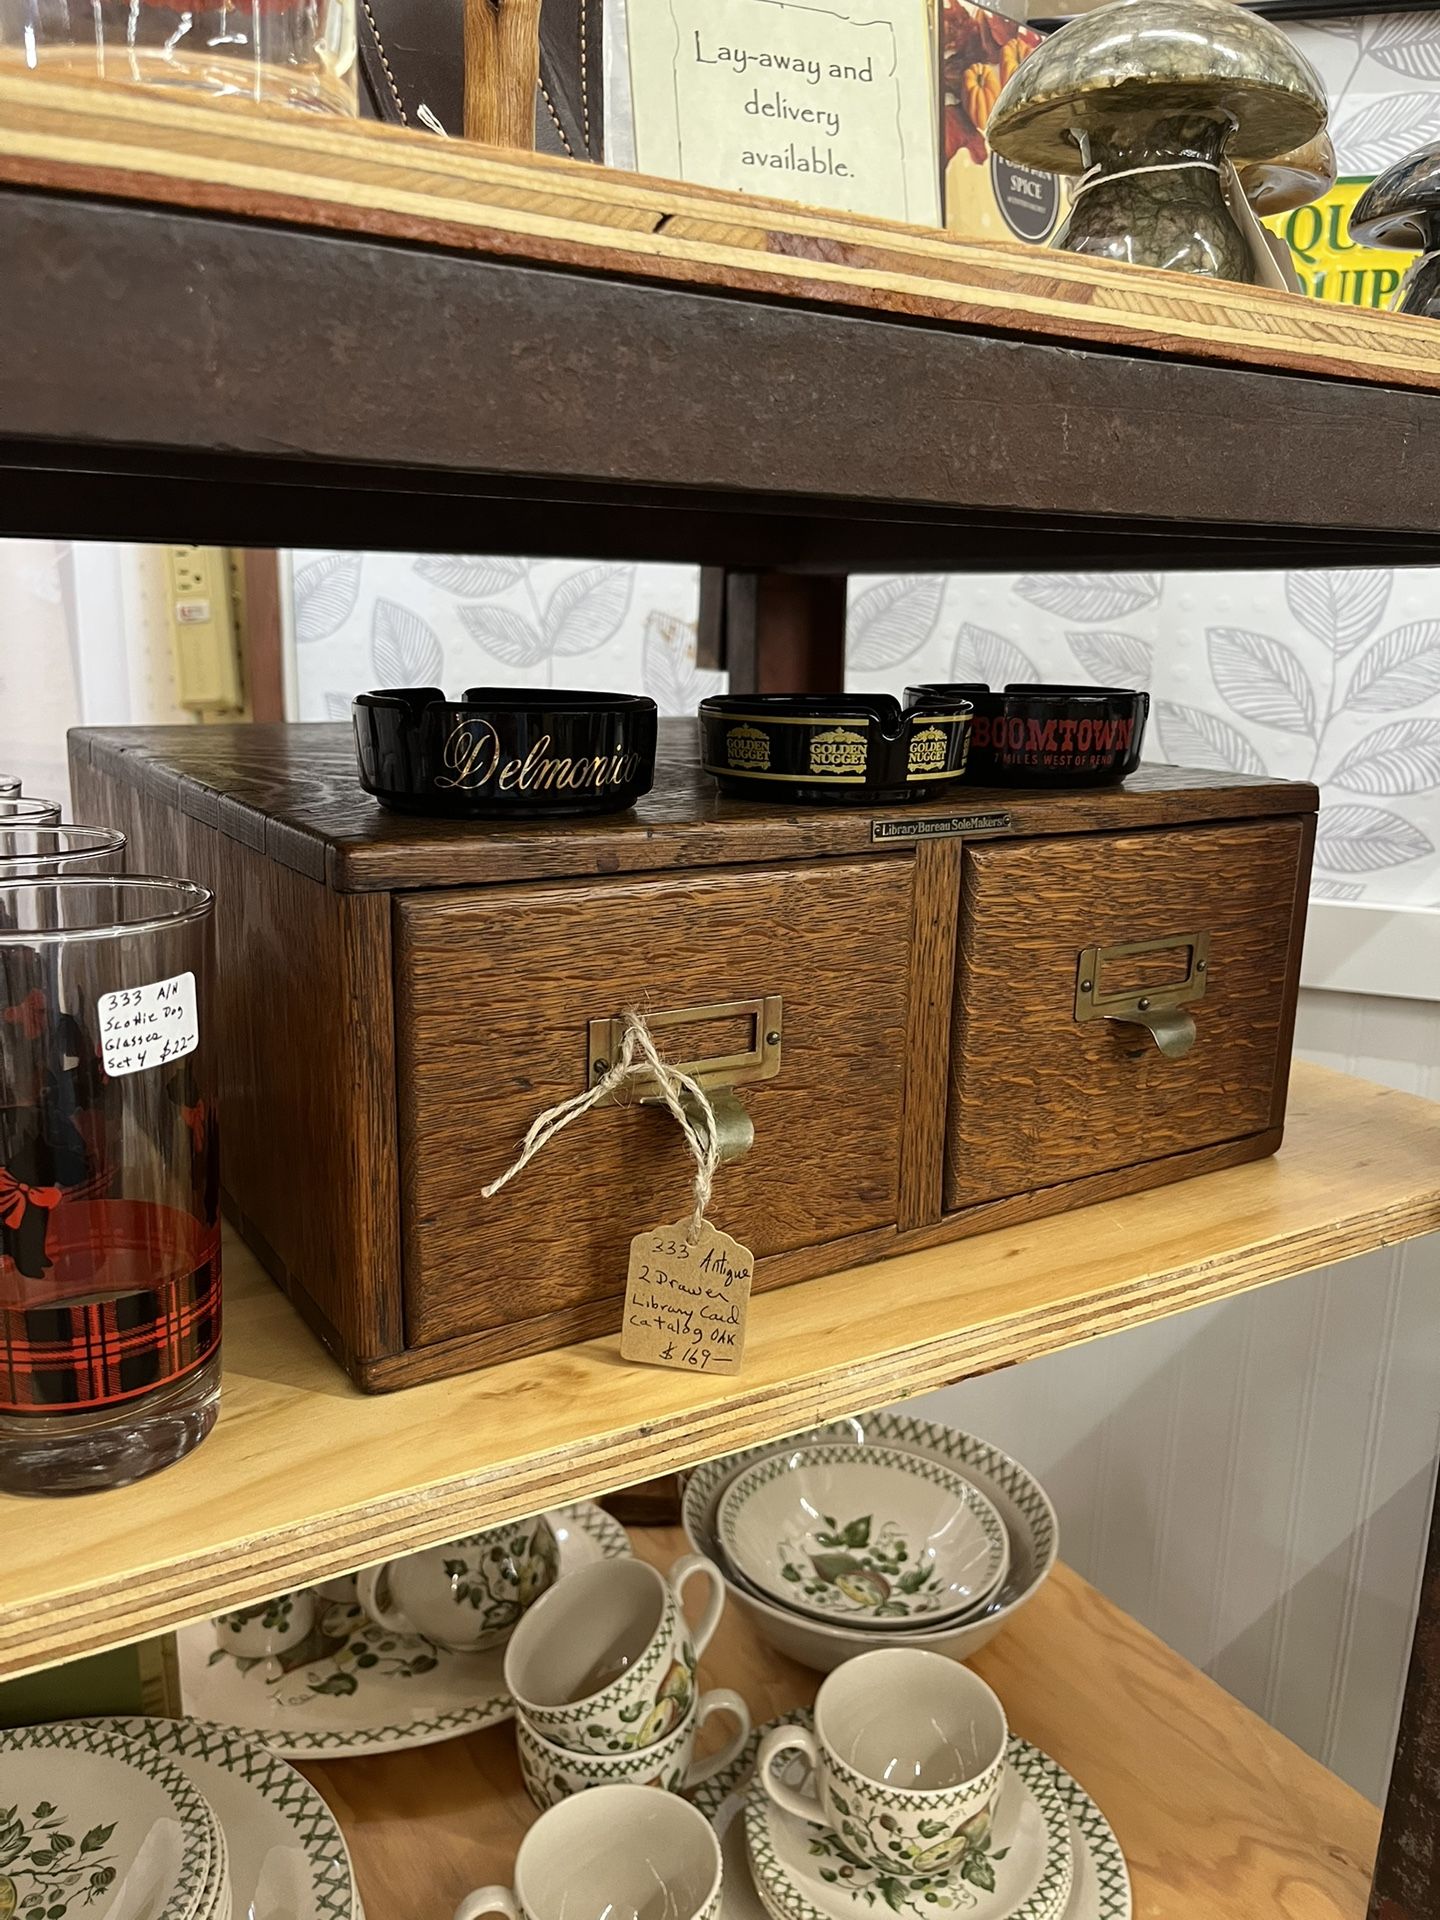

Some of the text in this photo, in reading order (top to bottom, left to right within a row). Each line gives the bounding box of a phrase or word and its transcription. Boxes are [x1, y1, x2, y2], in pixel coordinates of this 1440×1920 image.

[694, 30, 874, 85] Lay-away and
[743, 88, 840, 136] delivery
[741, 143, 855, 179] available.
[1010, 175, 1043, 200] SPICE
[971, 716, 1135, 752] BOOMTOWN
[726, 738, 770, 751] GOLDEN
[809, 744, 868, 757] GOLDEN
[909, 741, 947, 754] GOLDEN
[727, 749, 771, 761] NUGGET
[810, 754, 868, 764] NUGGET
[908, 751, 945, 762] NUGGET
[1003, 754, 1038, 765] MILES
[1044, 754, 1071, 766] WEST
[1075, 755, 1086, 766] OF
[107, 990, 142, 1011] 333
[162, 1006, 183, 1020] Dog
[108, 1057, 132, 1069] Set
[137, 1050, 147, 1067] 4
[651, 1237, 690, 1259] 333
[638, 1265, 729, 1303] 2 Drawer
[632, 1293, 741, 1325] Library Card
